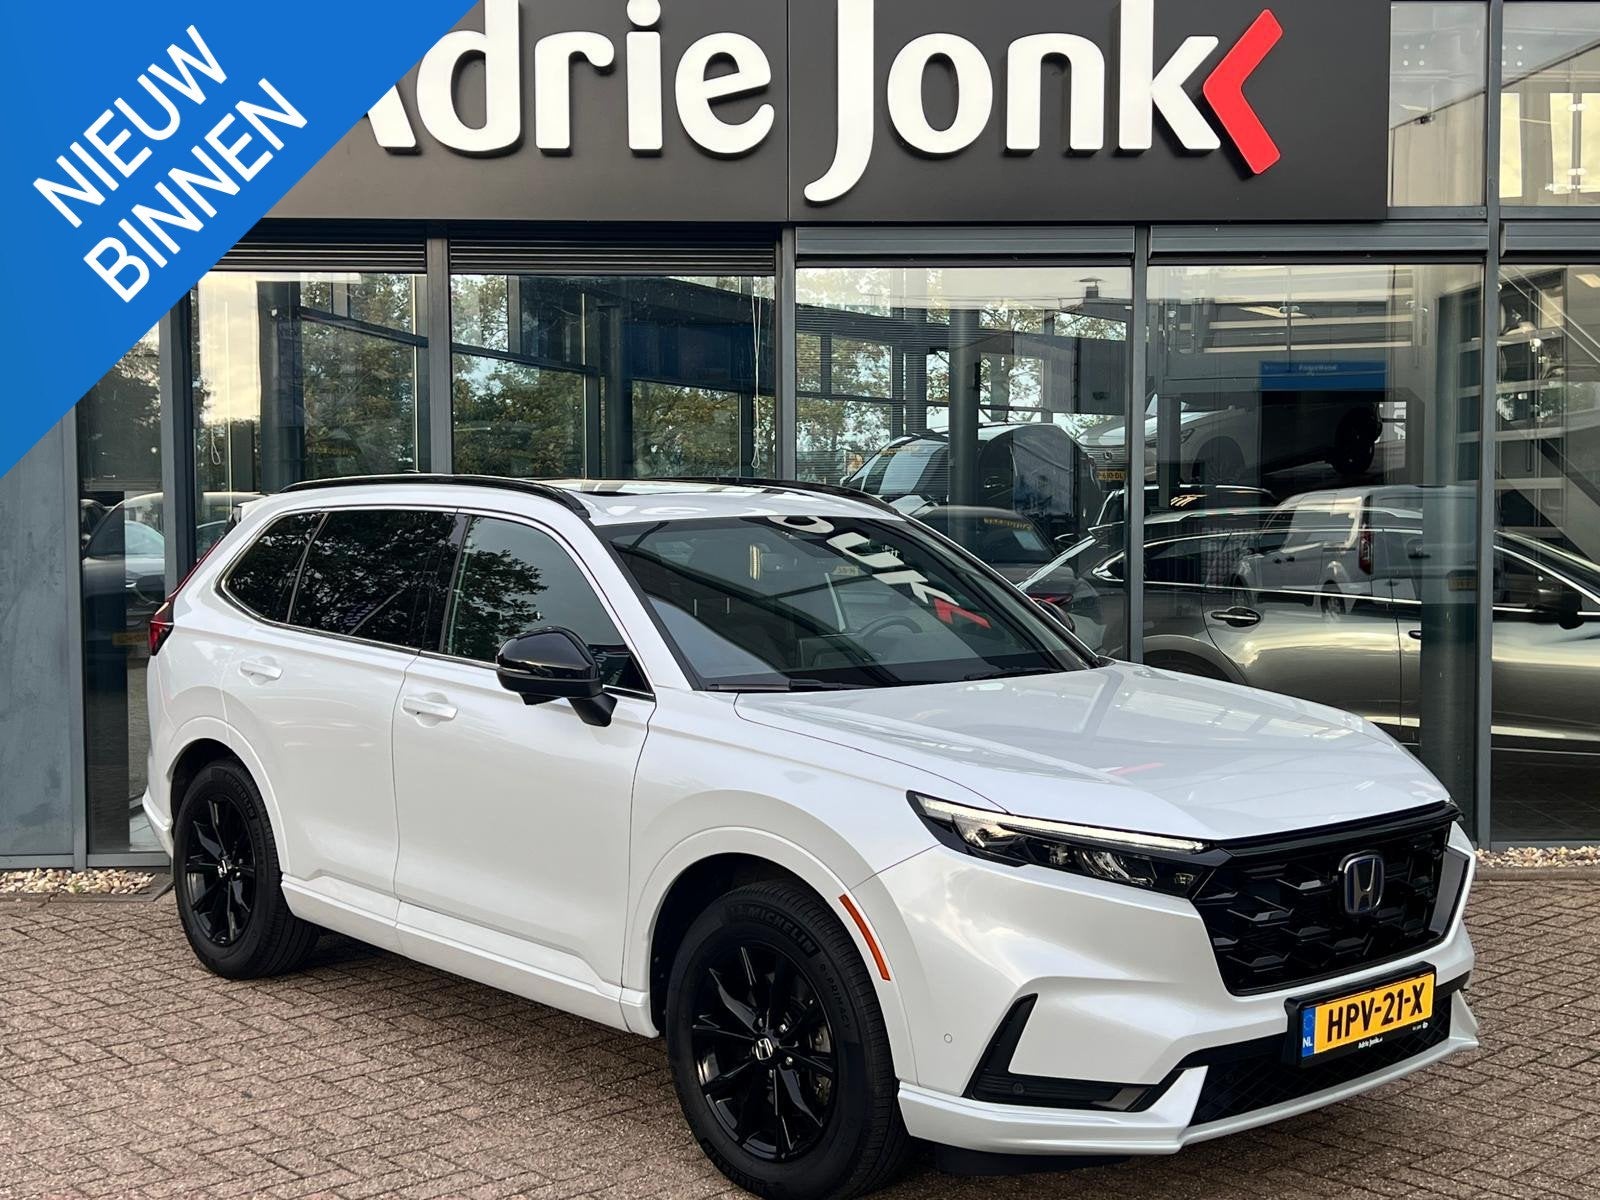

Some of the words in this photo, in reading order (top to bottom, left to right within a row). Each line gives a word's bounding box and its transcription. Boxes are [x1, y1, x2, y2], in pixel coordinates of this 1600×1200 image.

[366, 0, 775, 156] drie
[804, 0, 1221, 203] Jonk
[748, 906, 817, 954] MICHELIN
[1302, 1036, 1313, 1048] NL
[1327, 982, 1425, 1043] HPV-21-X
